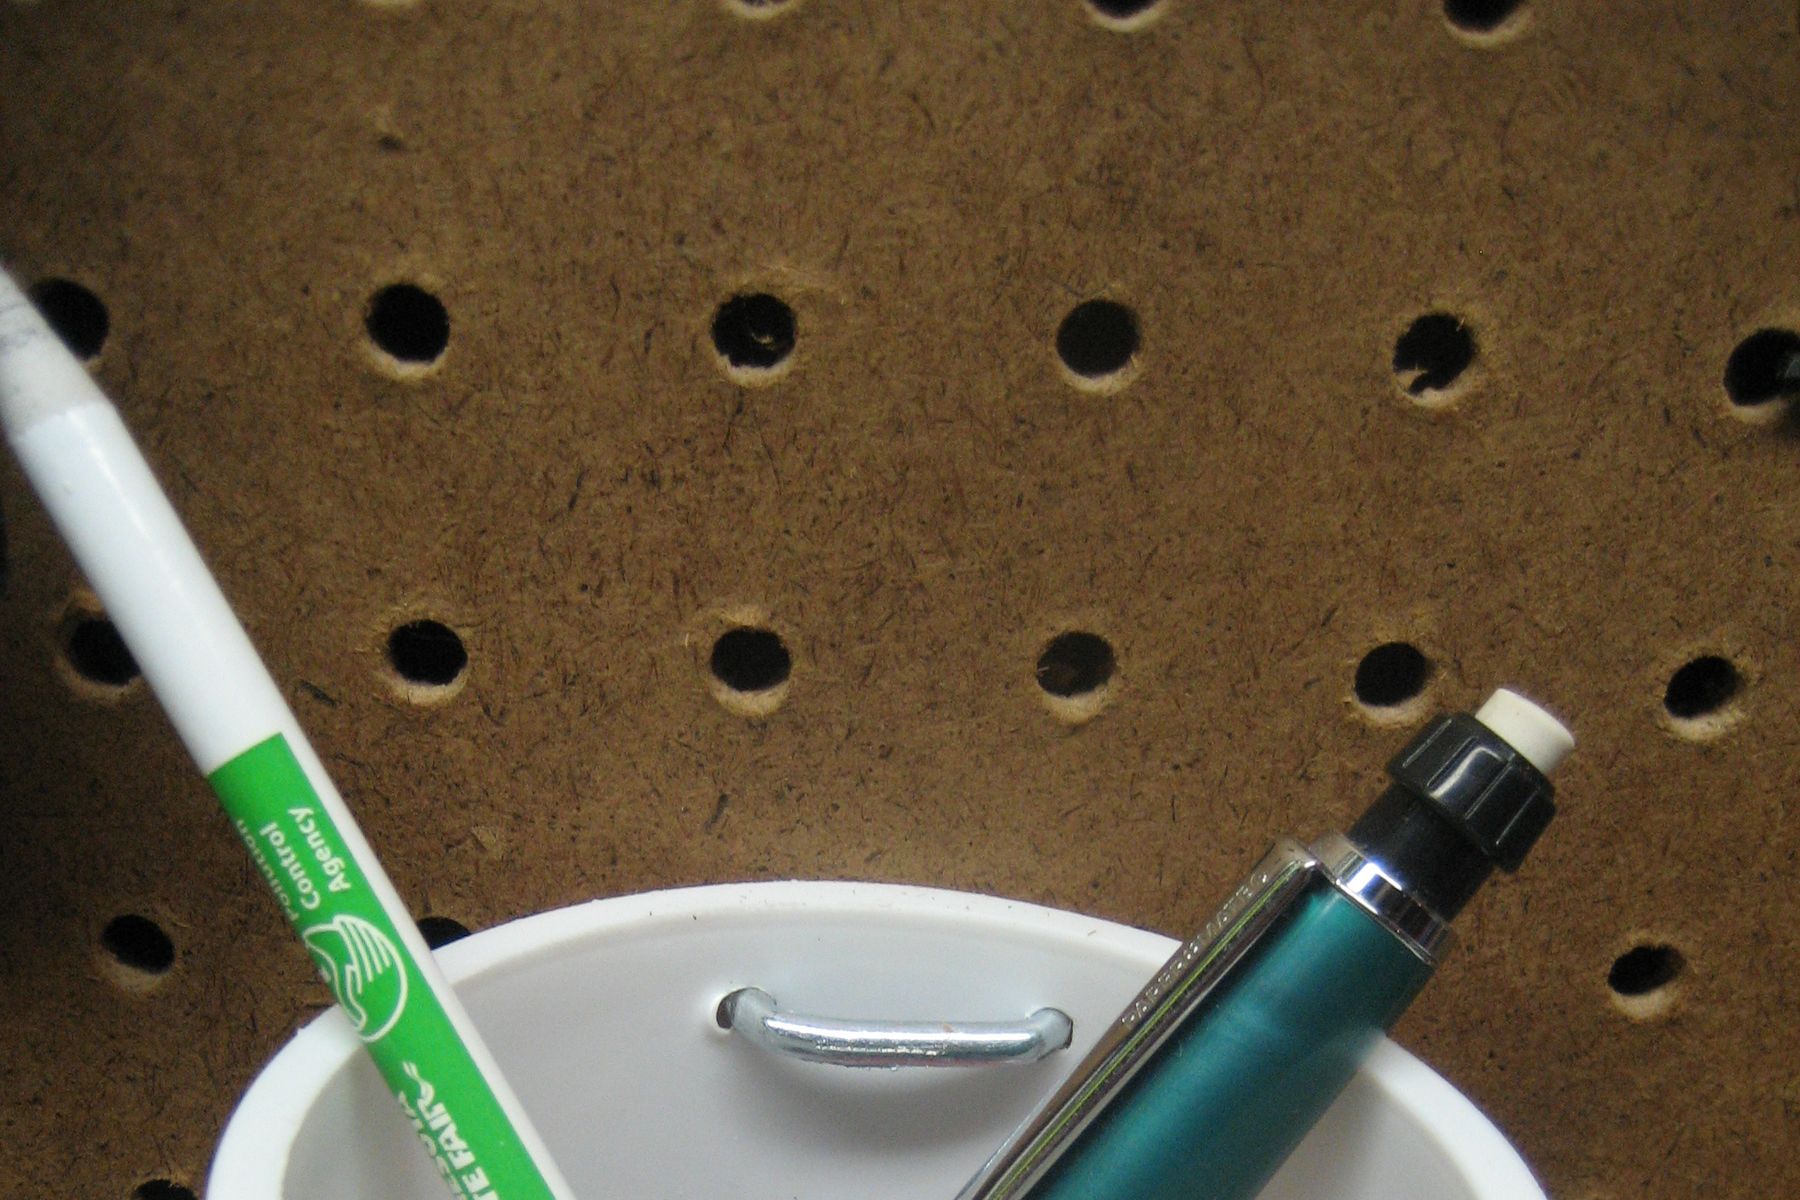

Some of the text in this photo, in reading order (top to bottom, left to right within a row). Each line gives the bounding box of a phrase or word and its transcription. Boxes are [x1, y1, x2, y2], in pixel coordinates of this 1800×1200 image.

[258, 821, 321, 910] Control
[288, 806, 351, 893] Agency
[408, 1068, 476, 1170] FAIR
